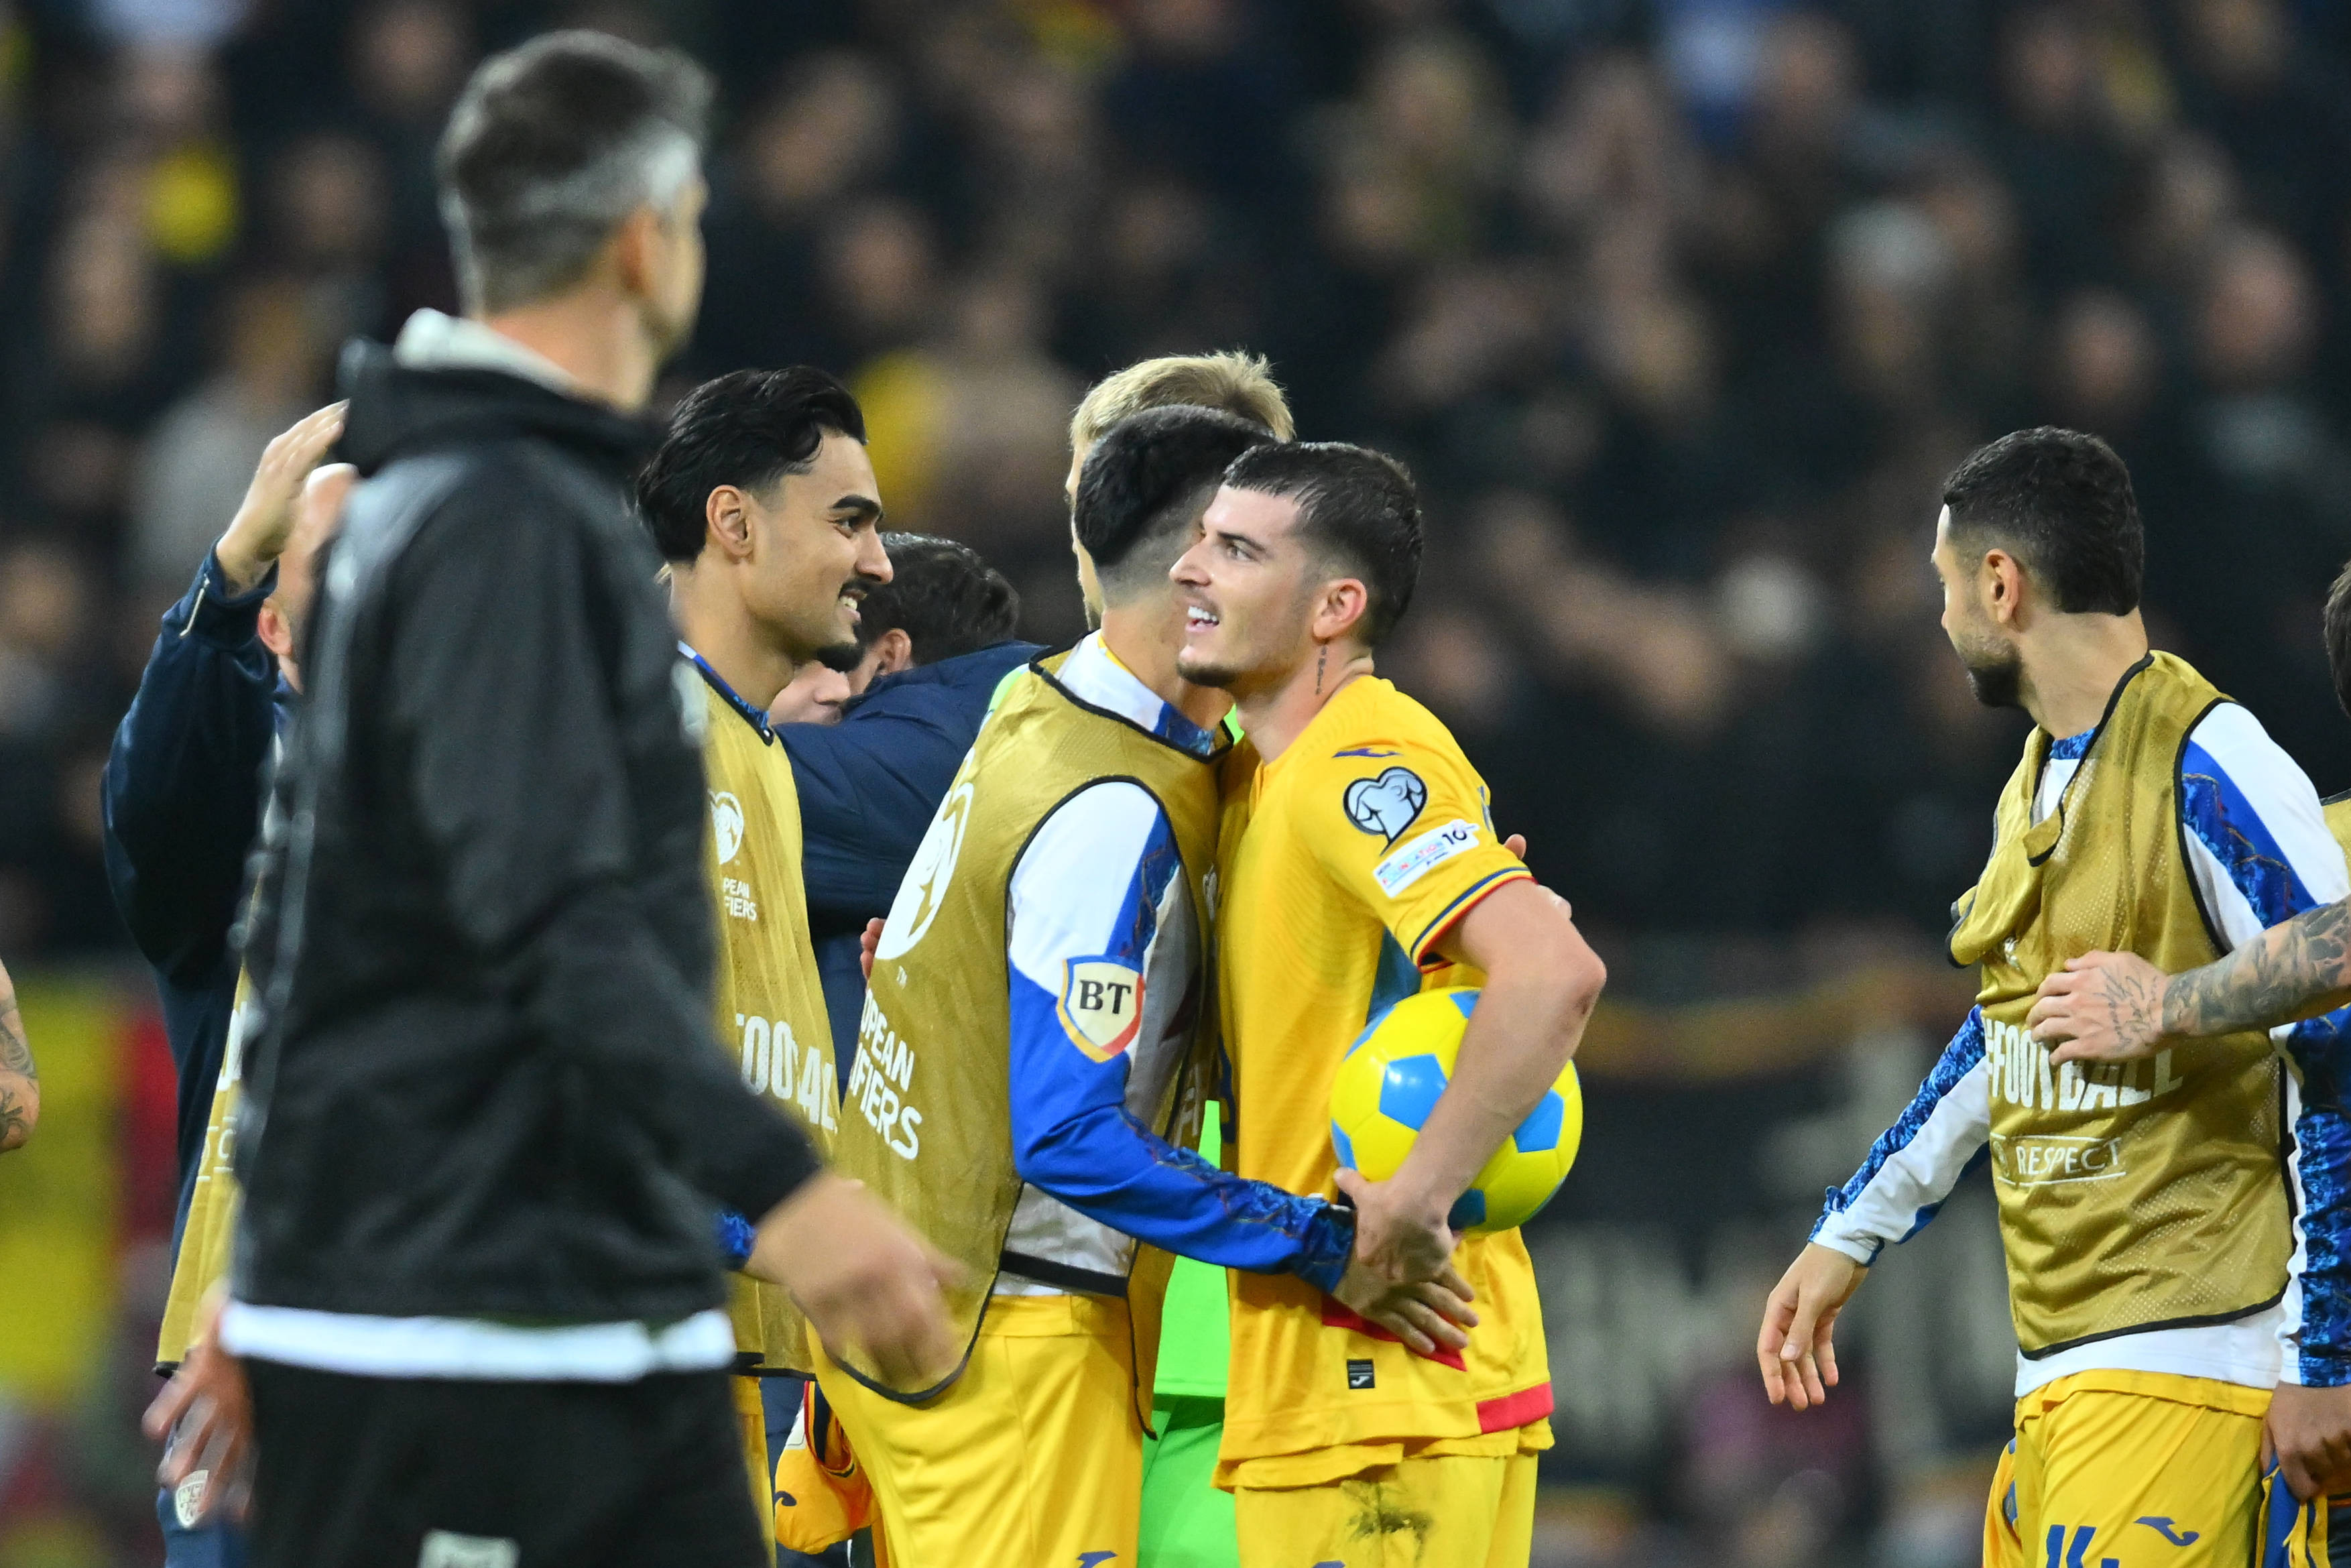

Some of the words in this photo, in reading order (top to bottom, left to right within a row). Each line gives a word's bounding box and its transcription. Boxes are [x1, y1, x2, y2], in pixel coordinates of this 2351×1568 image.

[1442, 830, 1467, 845] 10
[1079, 979, 1132, 1014] BT
[2016, 1137, 2122, 1175] RESPECT
